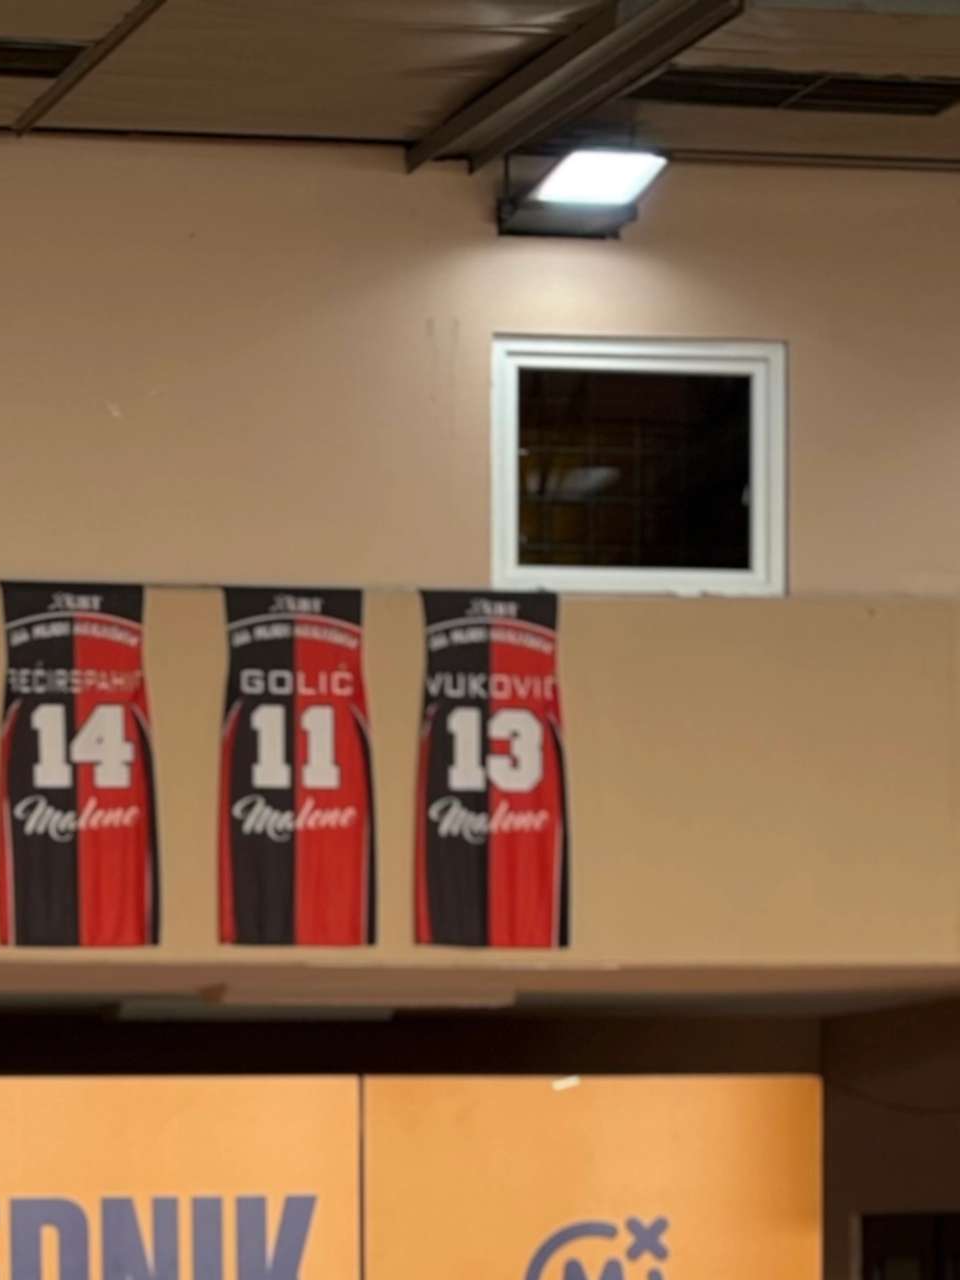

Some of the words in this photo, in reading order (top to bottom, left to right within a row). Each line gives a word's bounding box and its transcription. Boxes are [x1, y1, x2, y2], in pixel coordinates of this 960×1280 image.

[239, 662, 355, 697] GOLIĆ
[30, 704, 135, 789] 14
[251, 704, 340, 790] 11
[446, 706, 543, 793] 13
